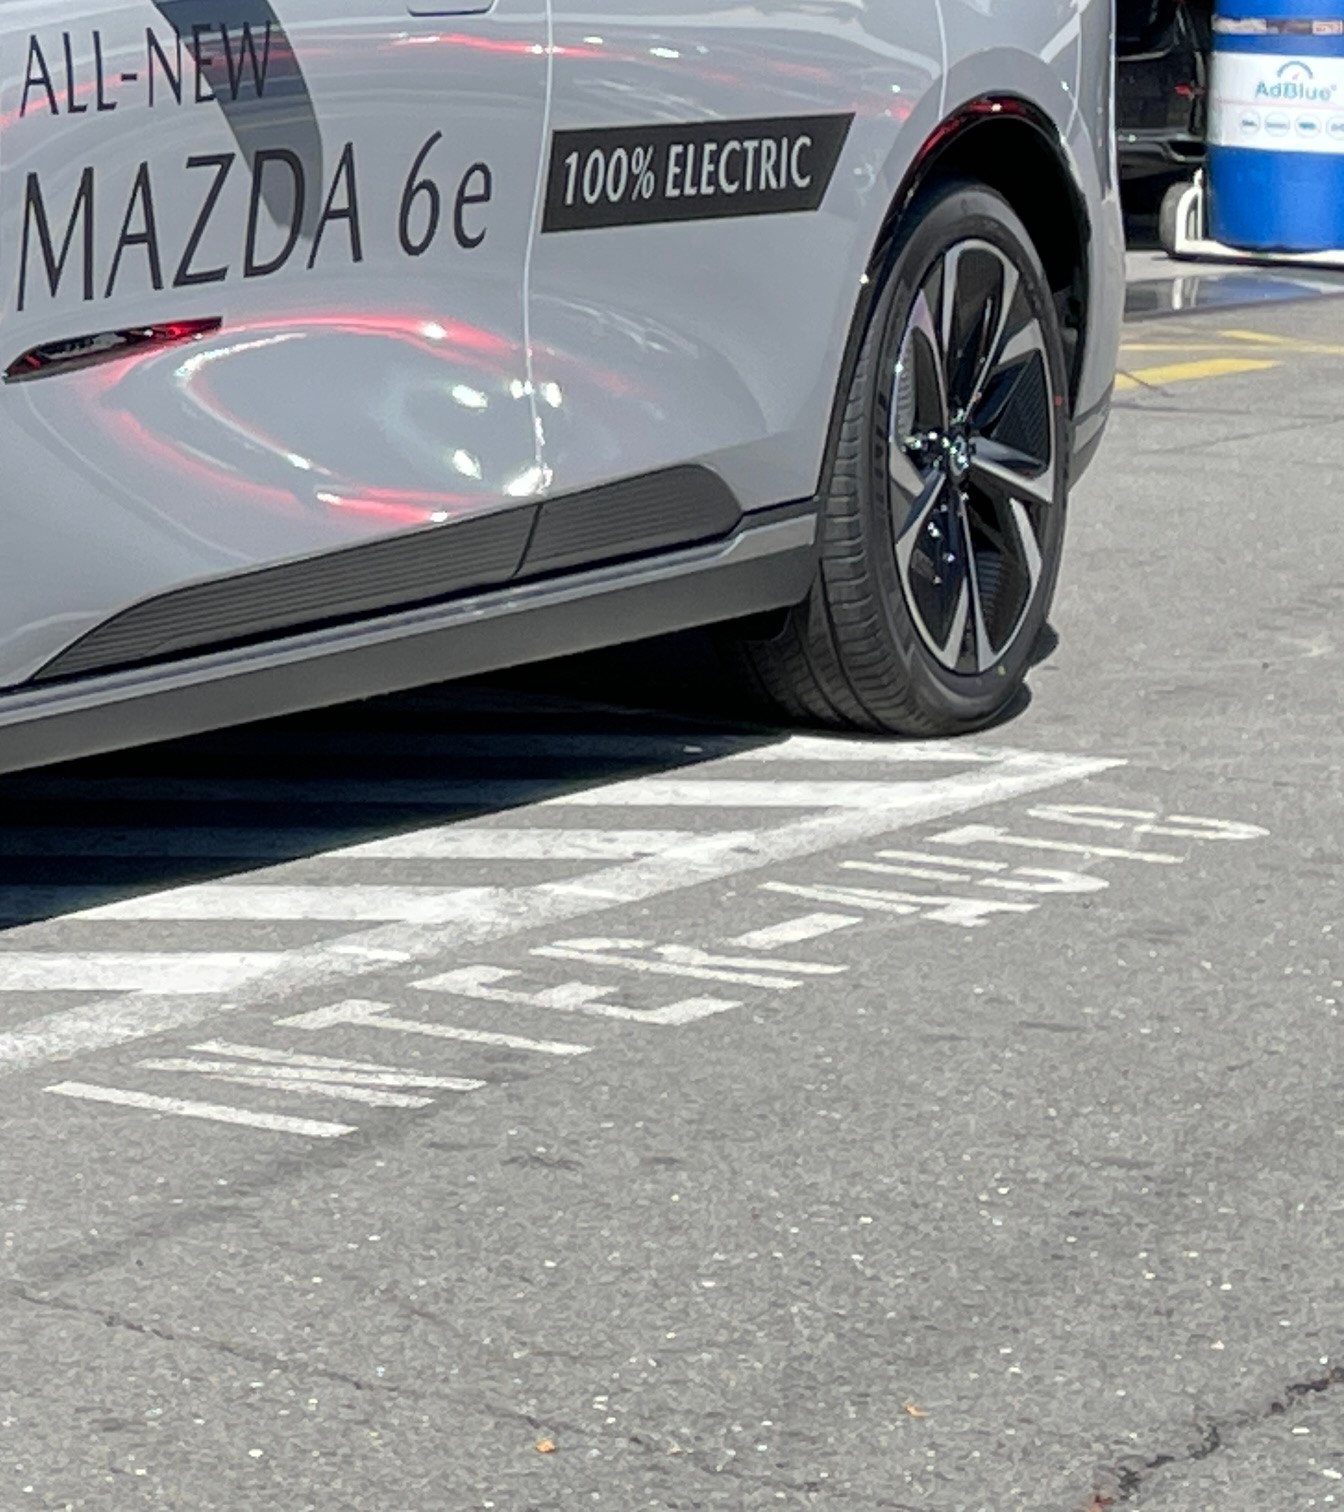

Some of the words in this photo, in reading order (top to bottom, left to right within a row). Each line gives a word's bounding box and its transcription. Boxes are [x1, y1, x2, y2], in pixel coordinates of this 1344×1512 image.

[20, 20, 273, 118] ALL-NEW
[17, 140, 364, 312] MAZDA
[398, 130, 494, 258] 6e
[563, 145, 655, 207] 100%
[664, 134, 813, 198] ELECTRIC
[42, 803, 1270, 1138] INTER-AUTO
